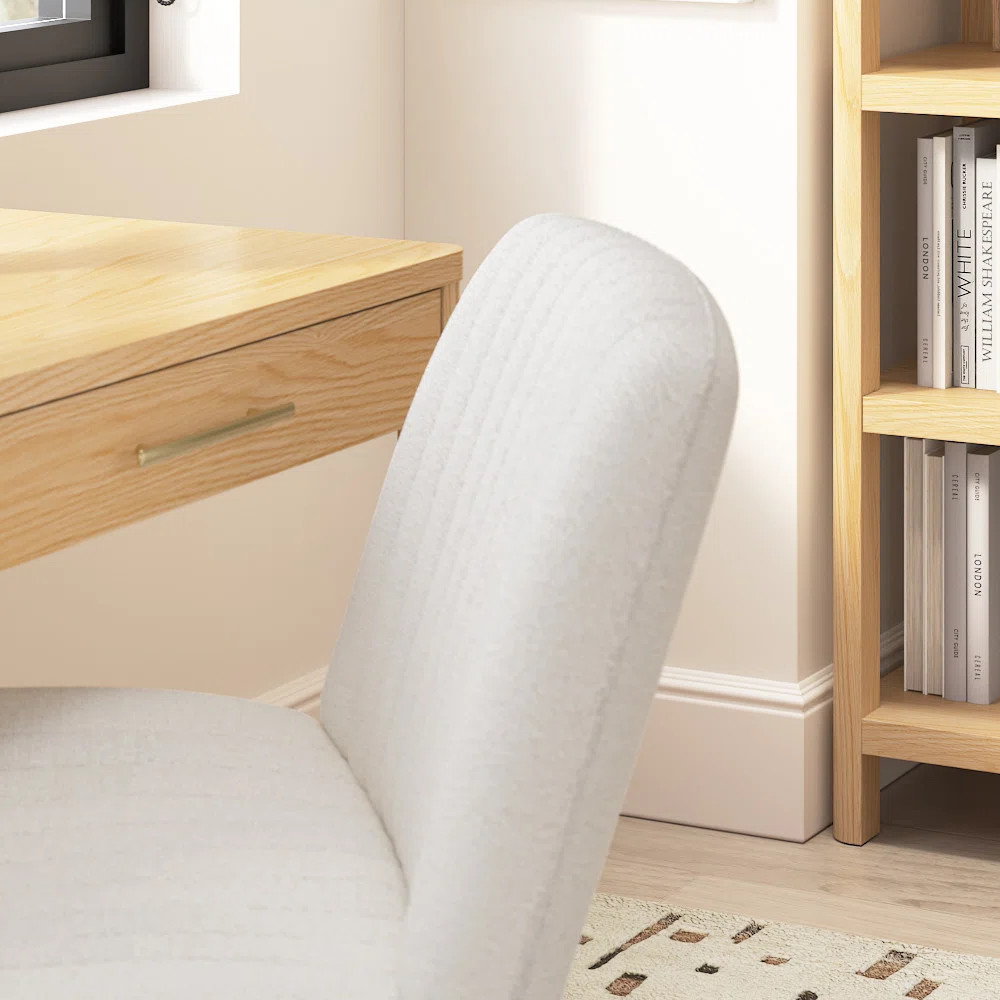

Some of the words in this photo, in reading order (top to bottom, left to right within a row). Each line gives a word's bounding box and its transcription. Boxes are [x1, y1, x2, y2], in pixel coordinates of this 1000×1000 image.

[957, 229, 972, 298] WHITE
[981, 181, 993, 288] SHAKESPEARE
[981, 293, 993, 362] WILLIAM
[951, 474, 959, 501] CEREAL
[974, 553, 982, 597] LONDON
